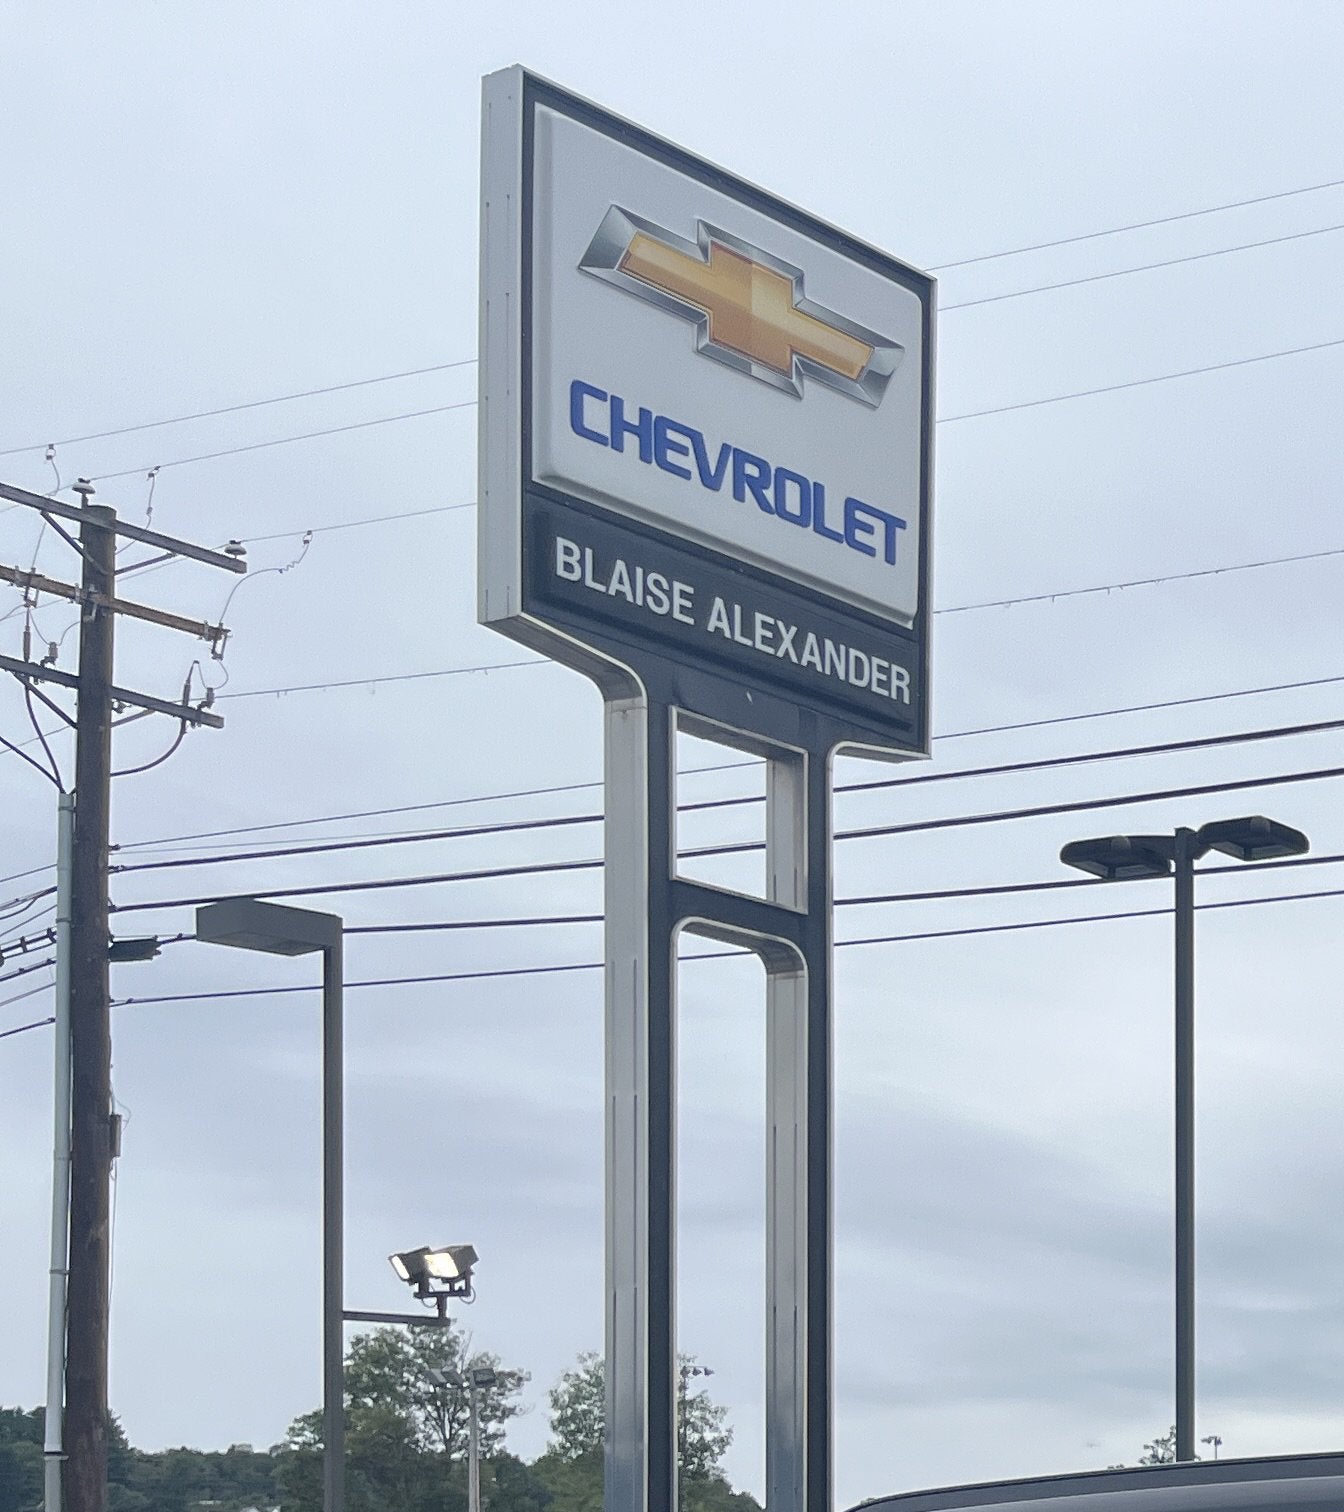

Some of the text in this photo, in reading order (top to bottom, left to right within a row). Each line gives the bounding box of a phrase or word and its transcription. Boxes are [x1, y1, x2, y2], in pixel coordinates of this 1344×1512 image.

[570, 379, 907, 565] CHEVROLET
[555, 536, 910, 704] BLAISE ALEXANDER
